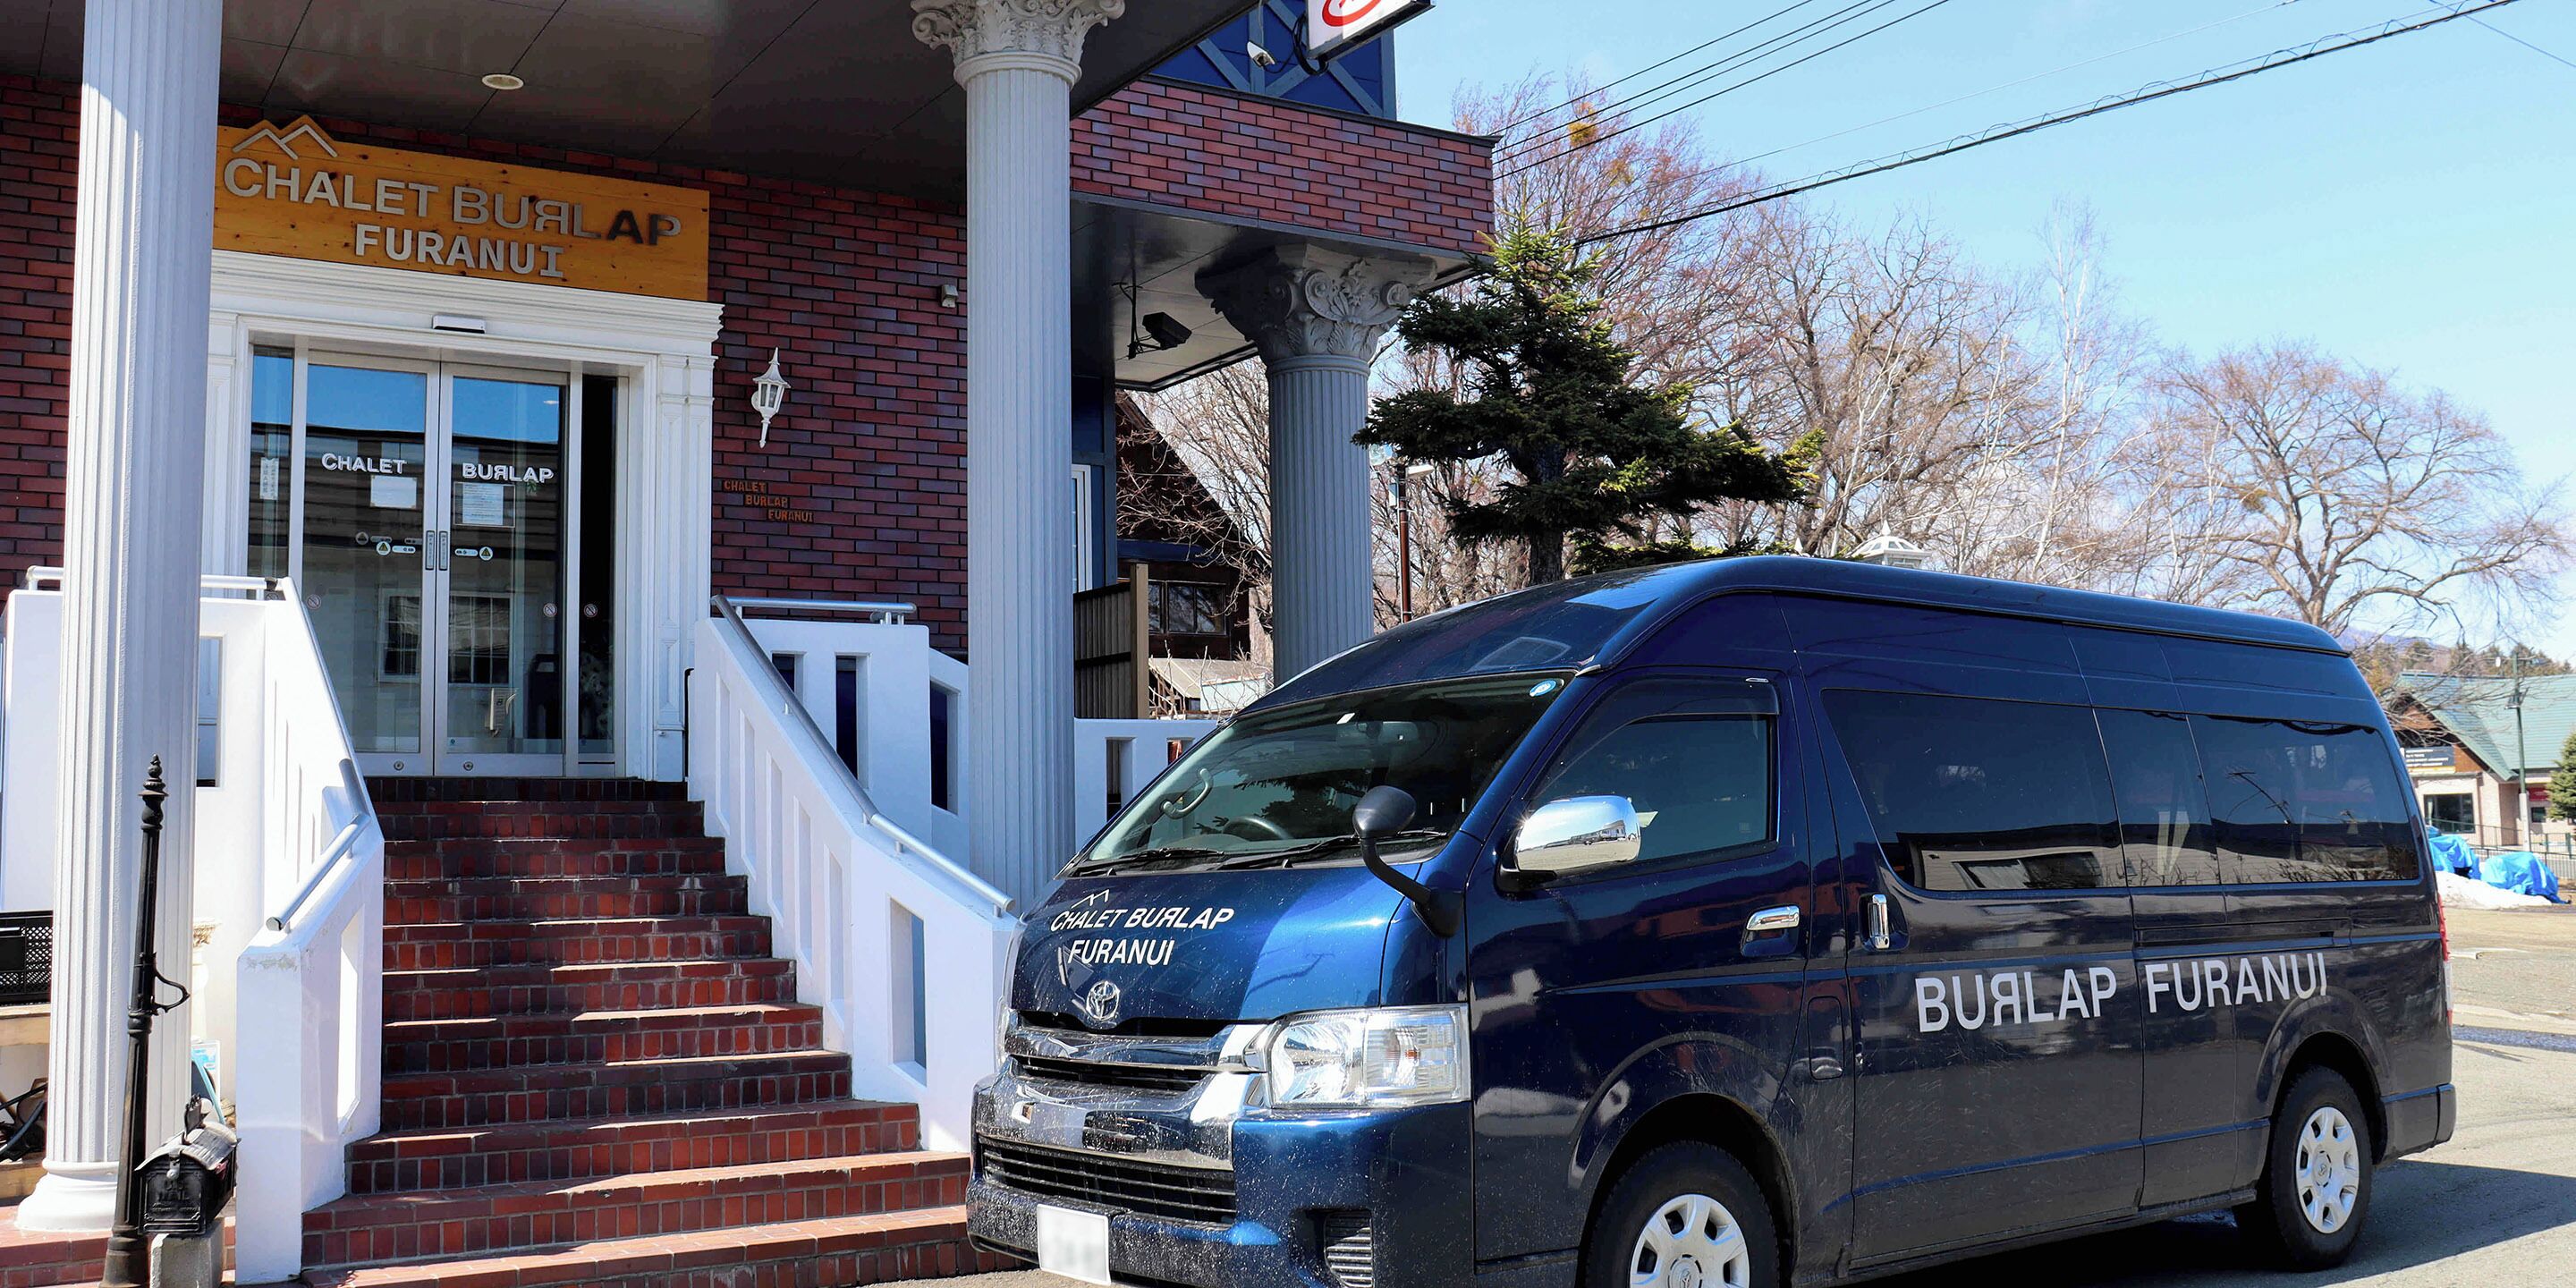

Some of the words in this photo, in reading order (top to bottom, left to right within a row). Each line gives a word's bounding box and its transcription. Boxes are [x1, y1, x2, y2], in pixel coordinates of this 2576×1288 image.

[224, 158, 439, 217] CHALET
[355, 224, 565, 277] FURANUI
[321, 453, 407, 474] CHALET
[724, 479, 766, 492] CHALET
[745, 494, 788, 507] BURLAP
[768, 510, 813, 522] FURANUI
[1050, 907, 1128, 932] CHALET
[1067, 939, 1174, 965] FURANUI
[2145, 953, 2326, 1013] FURANUI
